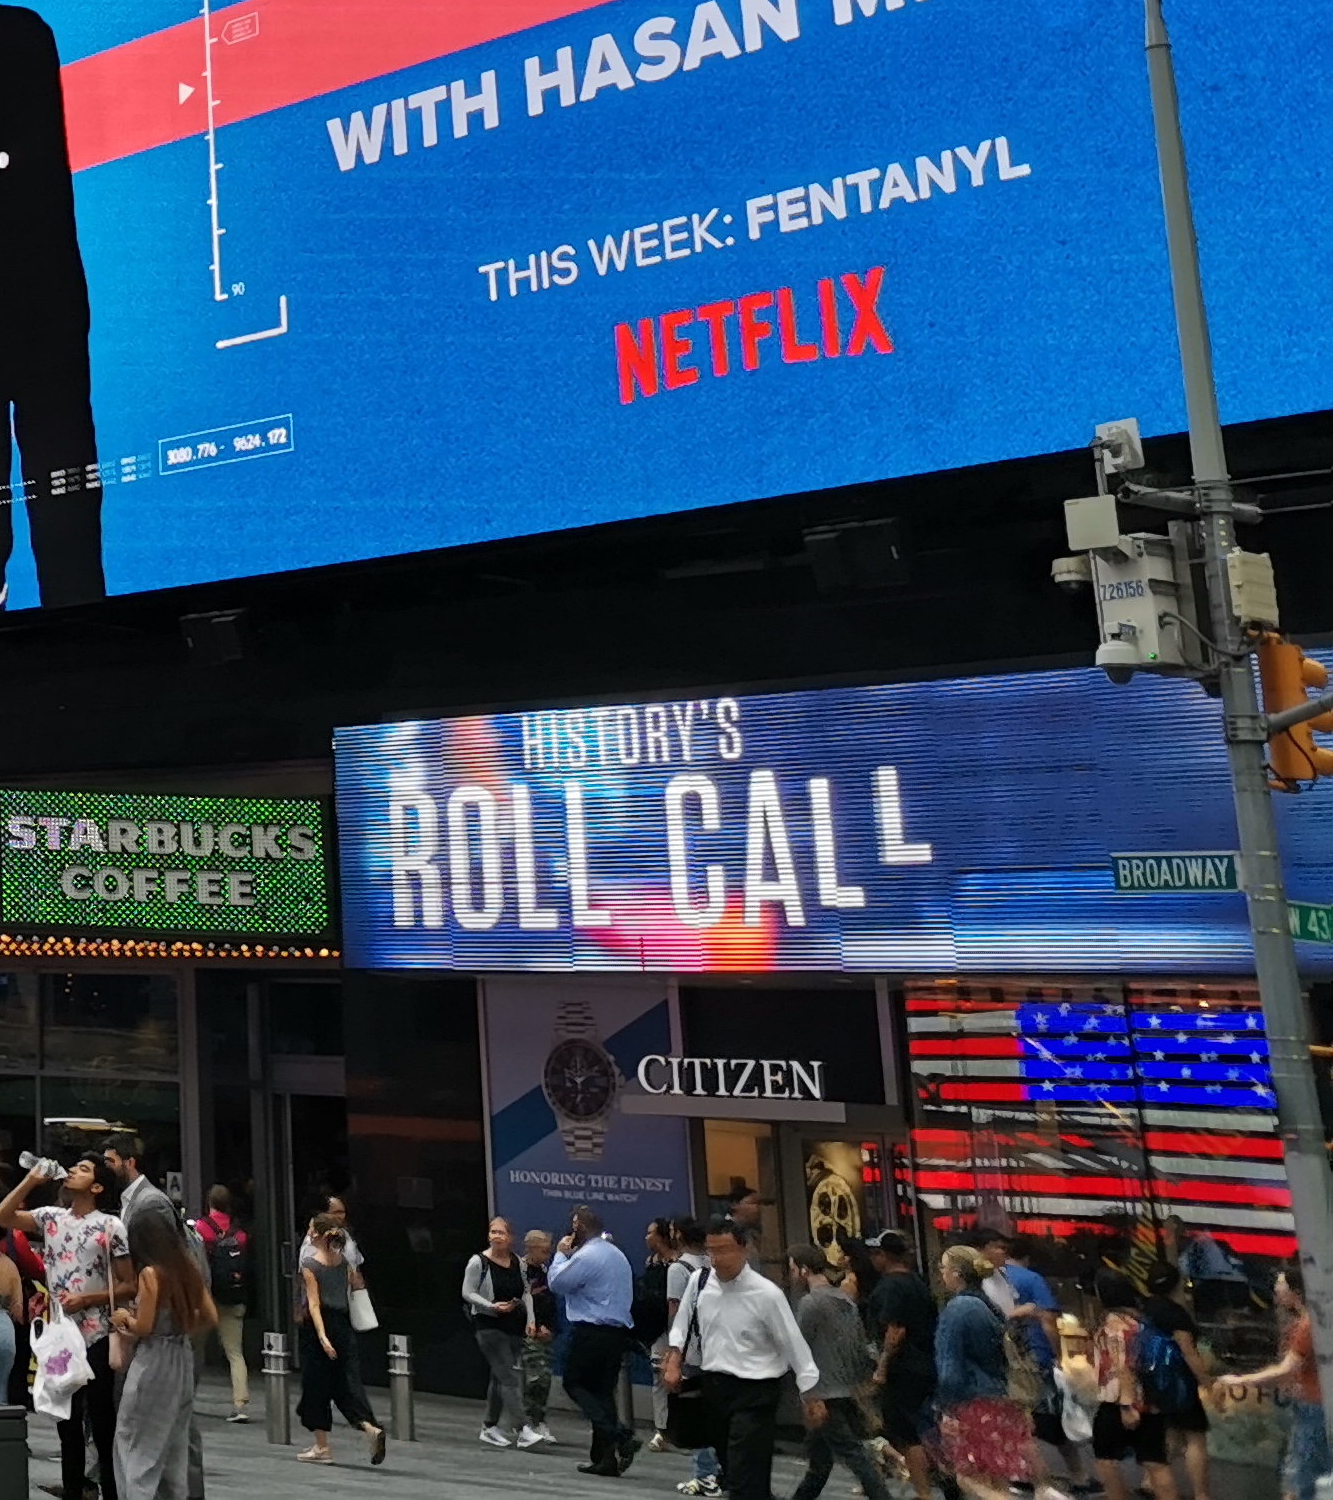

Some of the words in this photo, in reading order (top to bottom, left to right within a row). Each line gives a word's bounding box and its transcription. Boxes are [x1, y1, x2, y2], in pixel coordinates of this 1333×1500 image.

[326, 69, 500, 172] WITH
[479, 244, 578, 301] THIS
[587, 207, 735, 278] WEEK:
[746, 135, 1031, 241] FENTANYL
[614, 265, 894, 406] NETFLIX
[521, 696, 743, 770] HISTORY'S
[4, 814, 317, 861] STARBUCKS
[390, 779, 613, 931] ROLL
[664, 764, 933, 931] CALL
[60, 864, 256, 907] COFFEE
[1117, 857, 1229, 888] BROADWAY
[636, 1054, 824, 1100] CITIZEN
[509, 1169, 586, 1187] HONORING
[587, 1174, 619, 1190] THE
[620, 1175, 673, 1192] FINEST
